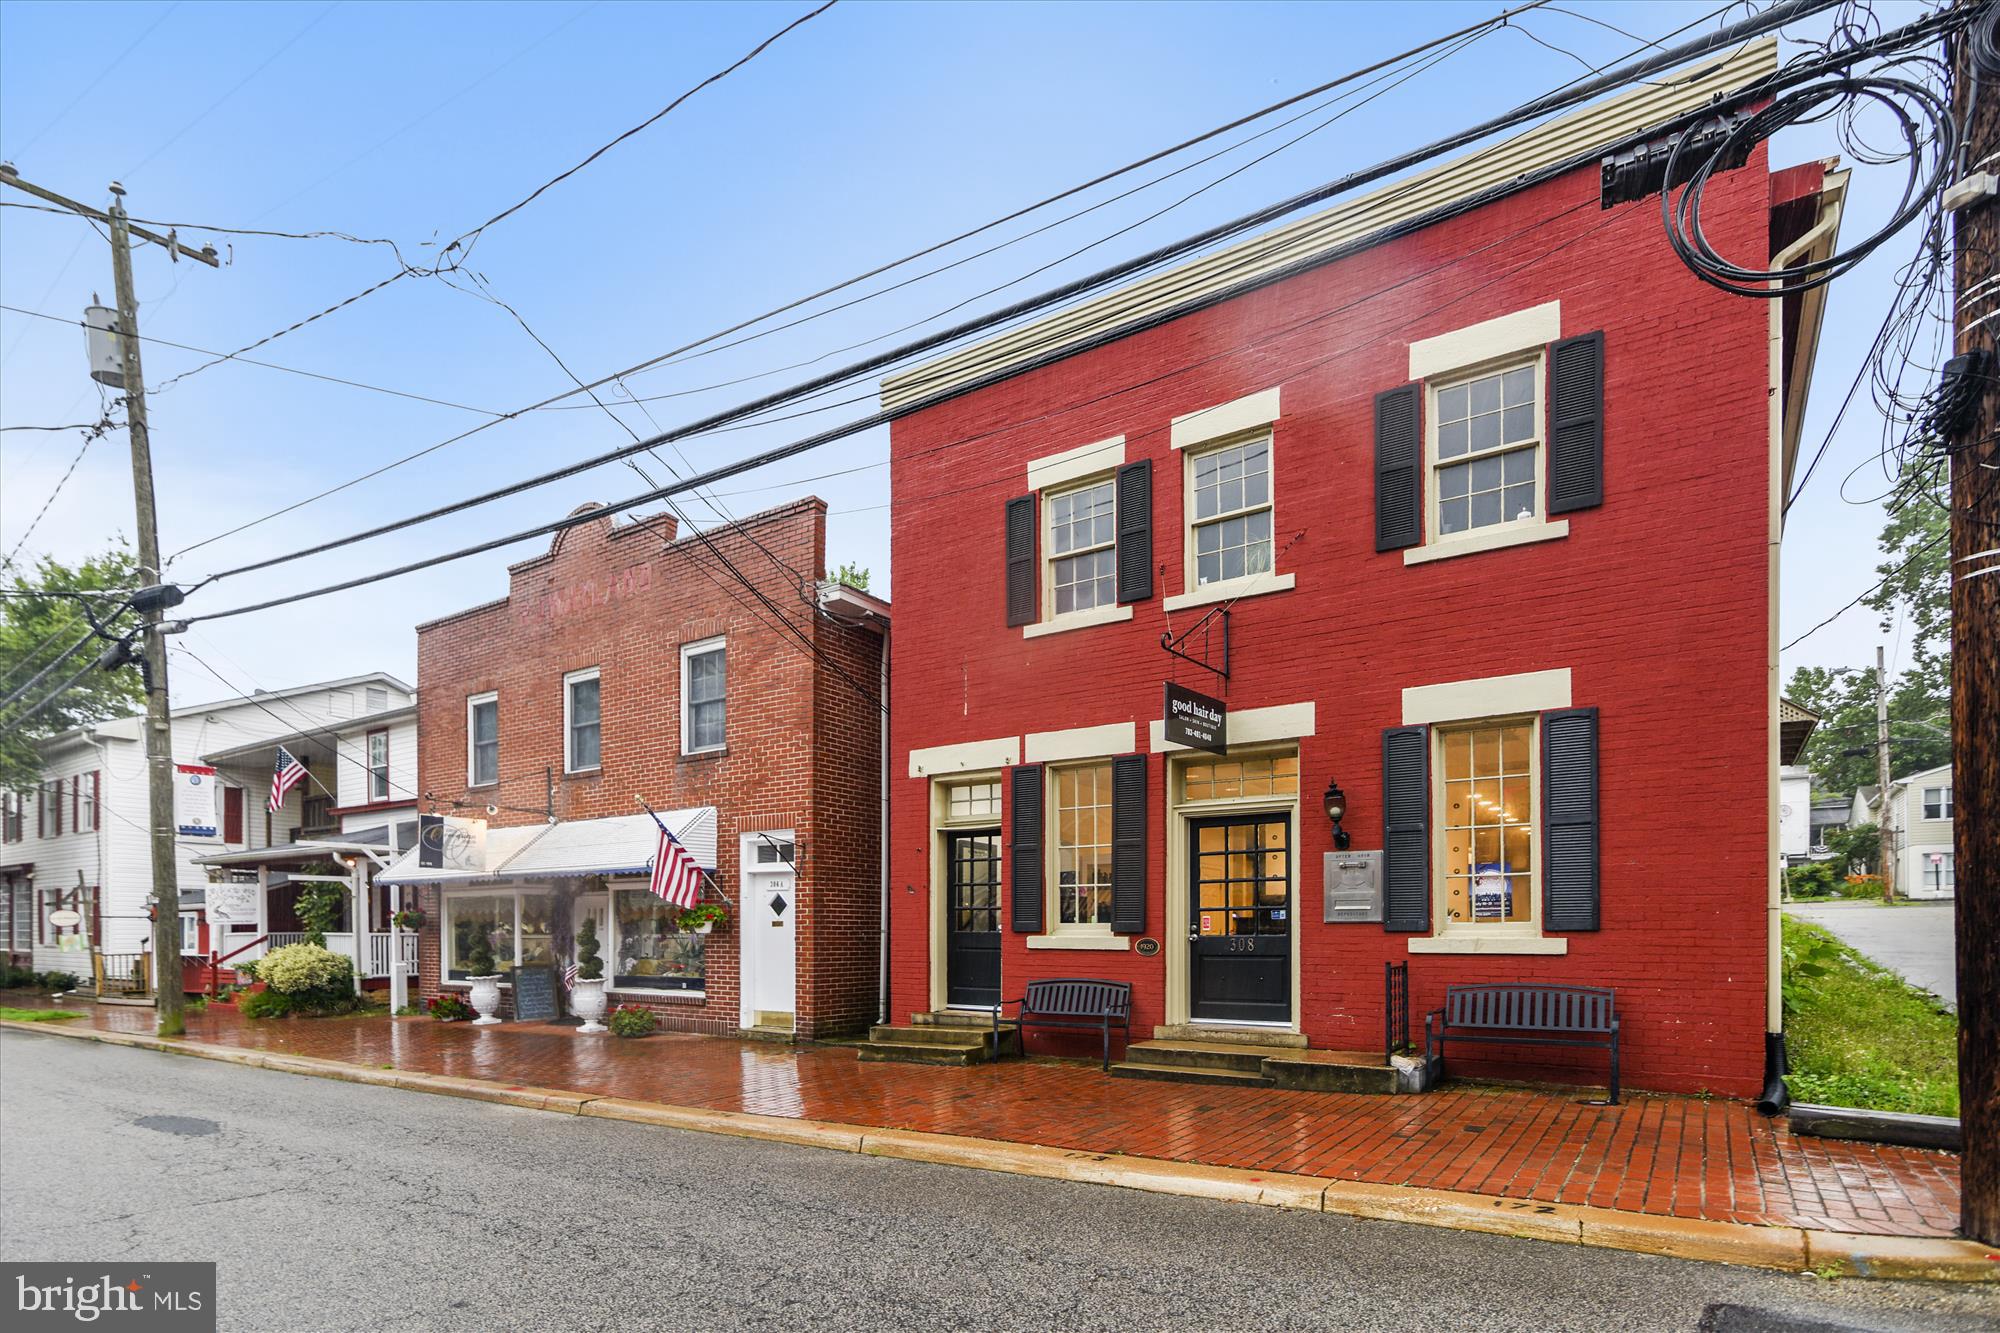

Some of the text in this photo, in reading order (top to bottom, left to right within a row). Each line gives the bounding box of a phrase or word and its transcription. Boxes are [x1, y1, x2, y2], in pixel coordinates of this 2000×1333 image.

[1172, 700, 1222, 727] good hair day
[1230, 938, 1254, 951] 308
